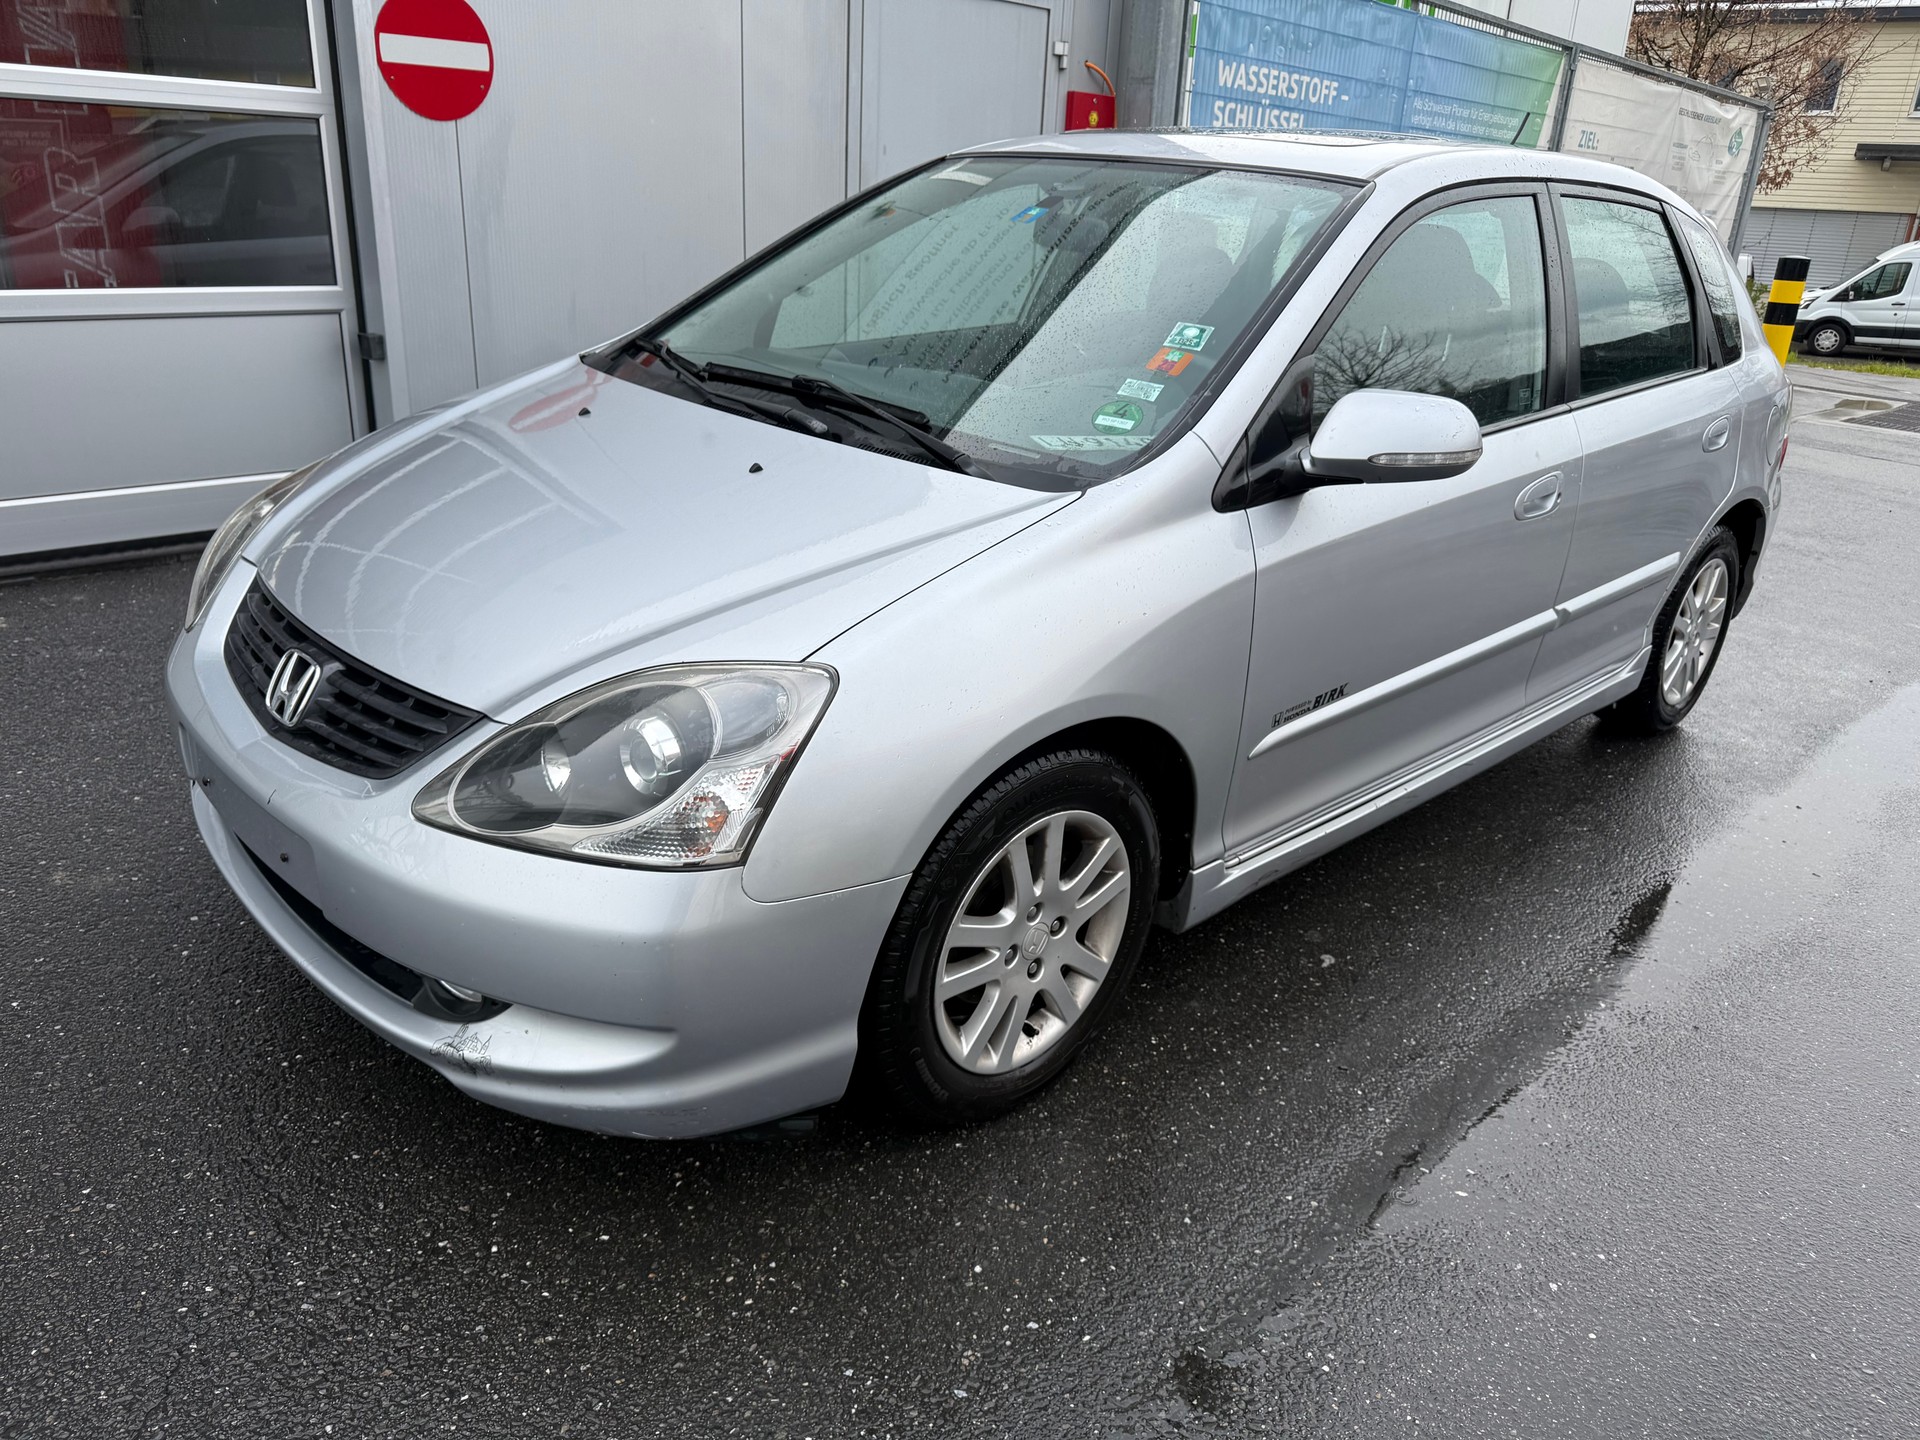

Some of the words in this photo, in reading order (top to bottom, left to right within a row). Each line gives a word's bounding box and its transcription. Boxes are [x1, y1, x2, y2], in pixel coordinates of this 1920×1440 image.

[1577, 129, 1600, 151] ZIEL:
[1113, 403, 1129, 418] 4
[1312, 682, 1350, 710] BIRK
